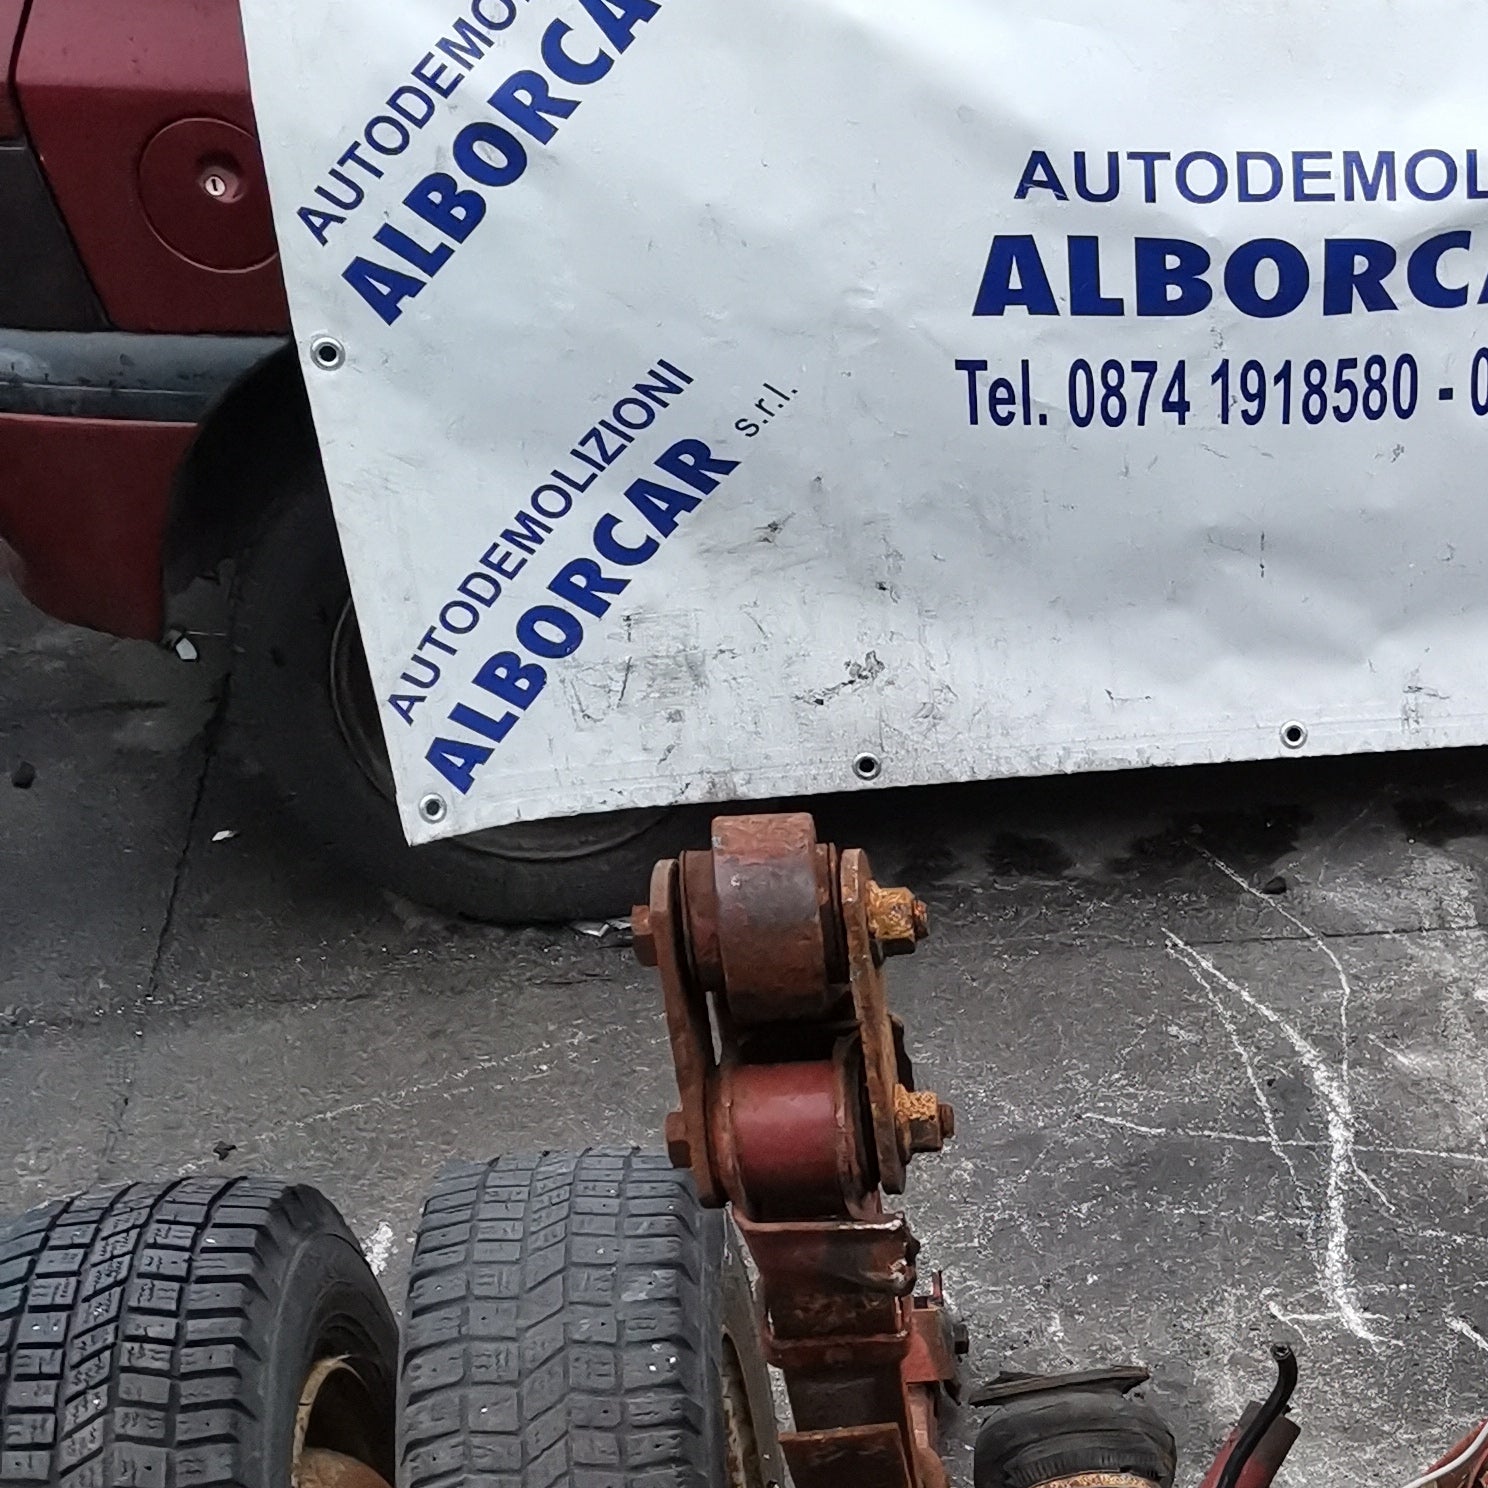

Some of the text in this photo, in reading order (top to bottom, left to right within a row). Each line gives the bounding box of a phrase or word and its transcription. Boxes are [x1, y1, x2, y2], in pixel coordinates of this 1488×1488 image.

[296, 0, 531, 246] AUTODEMO
[387, 359, 694, 726] AUTODEMOLIZIONI
[955, 358, 1048, 428] Tel.
[1068, 358, 1191, 430] 0874
[1212, 353, 1417, 426] 1918580
[425, 383, 798, 795] ALBORCAR s.r.l.
